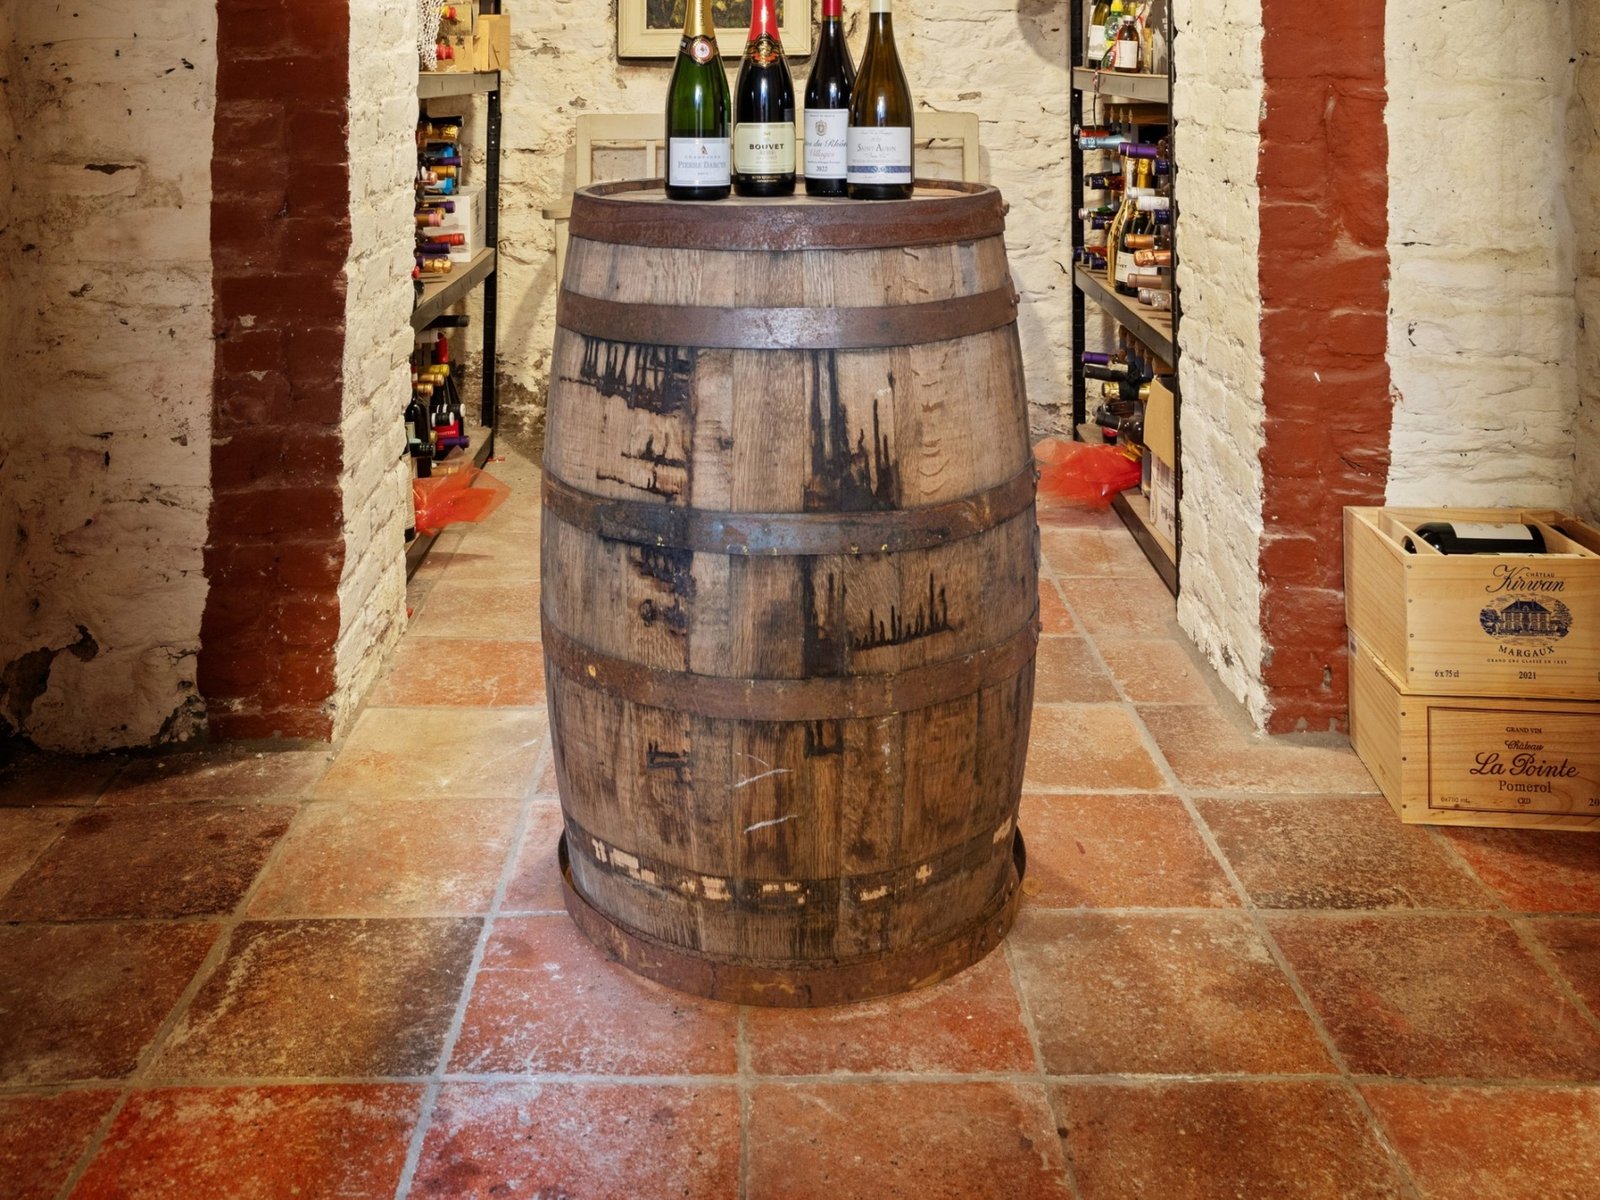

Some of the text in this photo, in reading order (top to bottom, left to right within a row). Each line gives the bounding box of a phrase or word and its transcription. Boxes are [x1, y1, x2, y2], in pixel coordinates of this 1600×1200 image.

[1485, 564, 1566, 593] Kirwan
[1498, 645, 1556, 657] MARGAUX
[1518, 671, 1536, 680] 2021
[1504, 740, 1544, 751] Château
[1469, 752, 1580, 778] La Pointe
[1498, 780, 1553, 793] Pomerol
